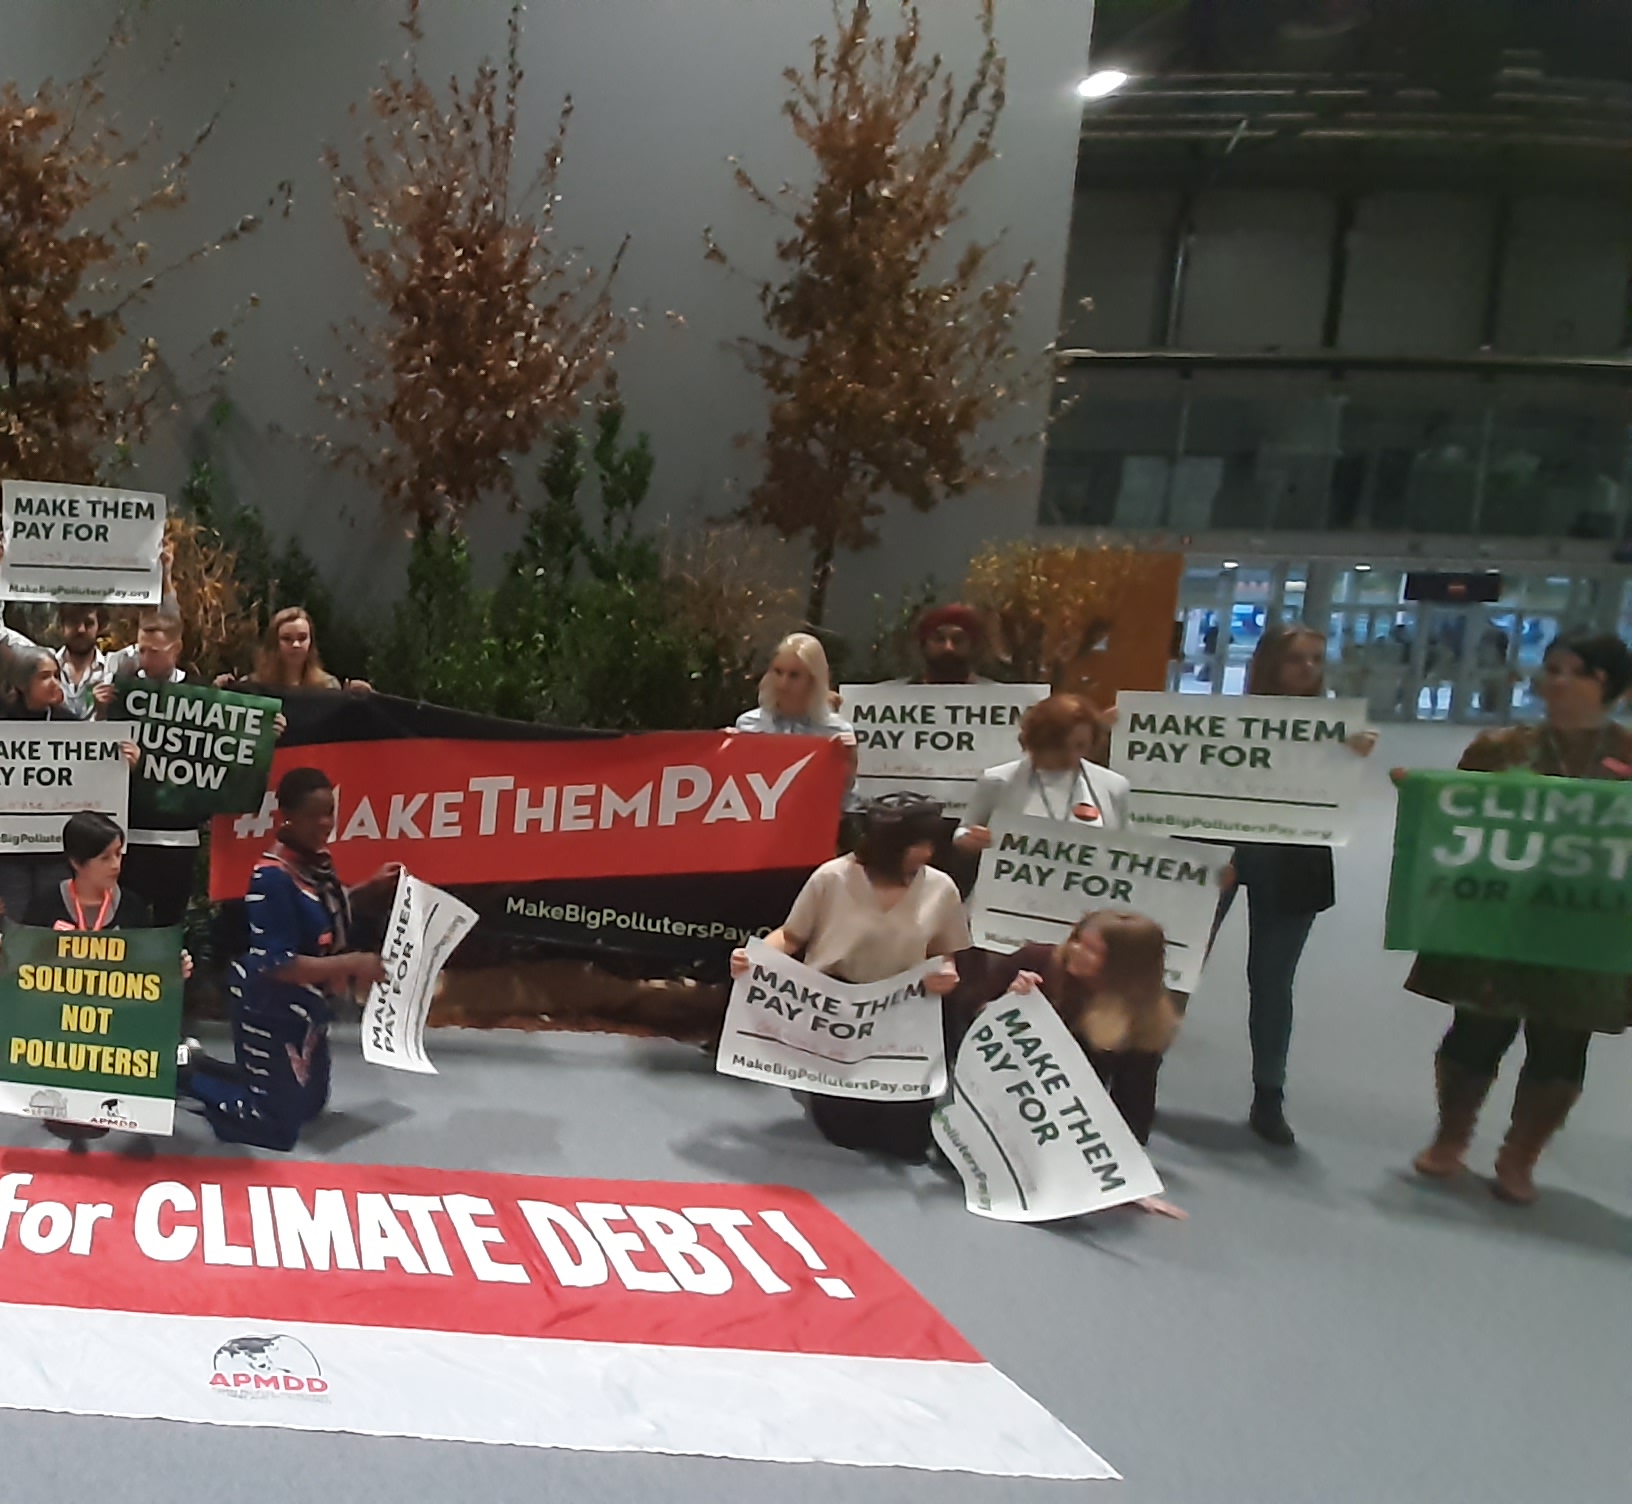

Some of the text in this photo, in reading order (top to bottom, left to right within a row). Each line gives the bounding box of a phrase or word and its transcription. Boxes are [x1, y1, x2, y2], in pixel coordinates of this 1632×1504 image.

[14, 498, 155, 520] MAKE THEM
[12, 521, 109, 542] PAY FOR
[126, 690, 264, 735] CLIMATE
[852, 705, 936, 725] MAKE
[1129, 713, 1345, 743] MAKE THEM
[48, 741, 119, 761] THEM
[856, 730, 975, 751] PAY FOR
[1127, 741, 1271, 768] PAY FOR
[23, 767, 73, 786] FOR
[143, 754, 227, 790] NOW
[999, 833, 1209, 886] MAKE THEM
[994, 859, 1134, 903] PAY FOR
[390, 886, 413, 961] THEM
[58, 936, 126, 961] FUND
[18, 965, 162, 1001] SOLUTIONS
[384, 942, 414, 1054] PAY FOR
[752, 964, 926, 1019] MAKE THEM
[61, 1003, 113, 1035] NOT
[746, 985, 803, 1021] PAY
[810, 1016, 875, 1040] FOR
[9, 1037, 159, 1079] POLLUTERS!
[971, 1025, 1060, 1146] PAY FOR
[996, 1008, 1070, 1096] MAKE
[1059, 1096, 1126, 1192] THEM
[133, 1181, 531, 1286] CLIMATE
[209, 1372, 328, 1393] APMDD
